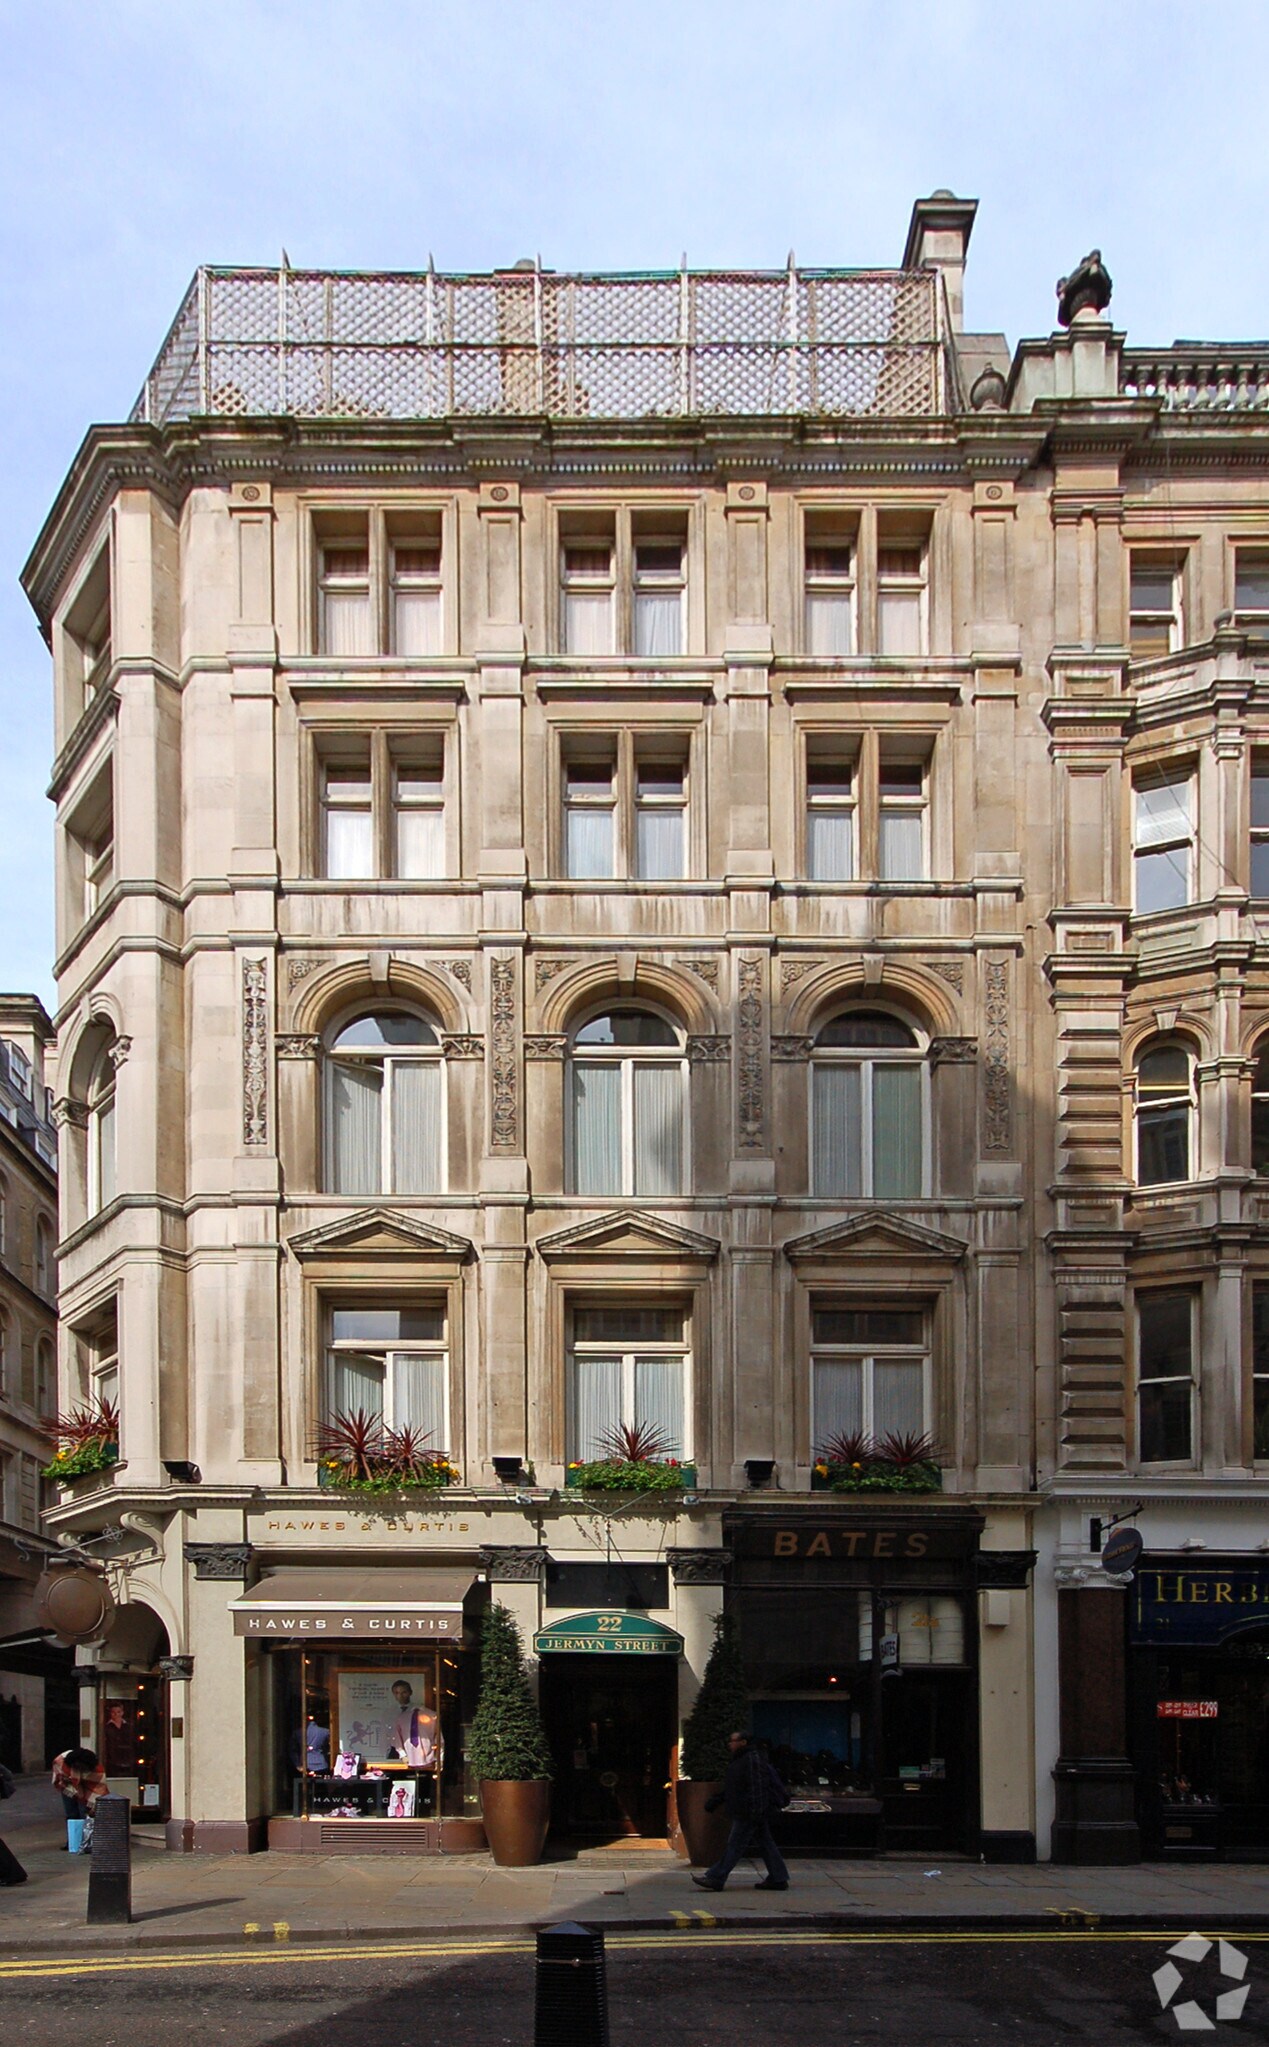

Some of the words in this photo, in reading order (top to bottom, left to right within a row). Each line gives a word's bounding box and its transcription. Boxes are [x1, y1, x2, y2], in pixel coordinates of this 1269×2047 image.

[269, 1521, 345, 1531] HAWES
[361, 1521, 372, 1531] &
[387, 1521, 470, 1533] CURTIS
[774, 1531, 929, 1558] BATES
[249, 1618, 327, 1629] HAWES
[341, 1618, 355, 1629] &
[369, 1619, 449, 1630] CURTIS
[597, 1616, 623, 1632] 22
[545, 1640, 605, 1650] JERMYN
[614, 1641, 670, 1652] STREET
[1200, 1701, 1219, 1718] £299
